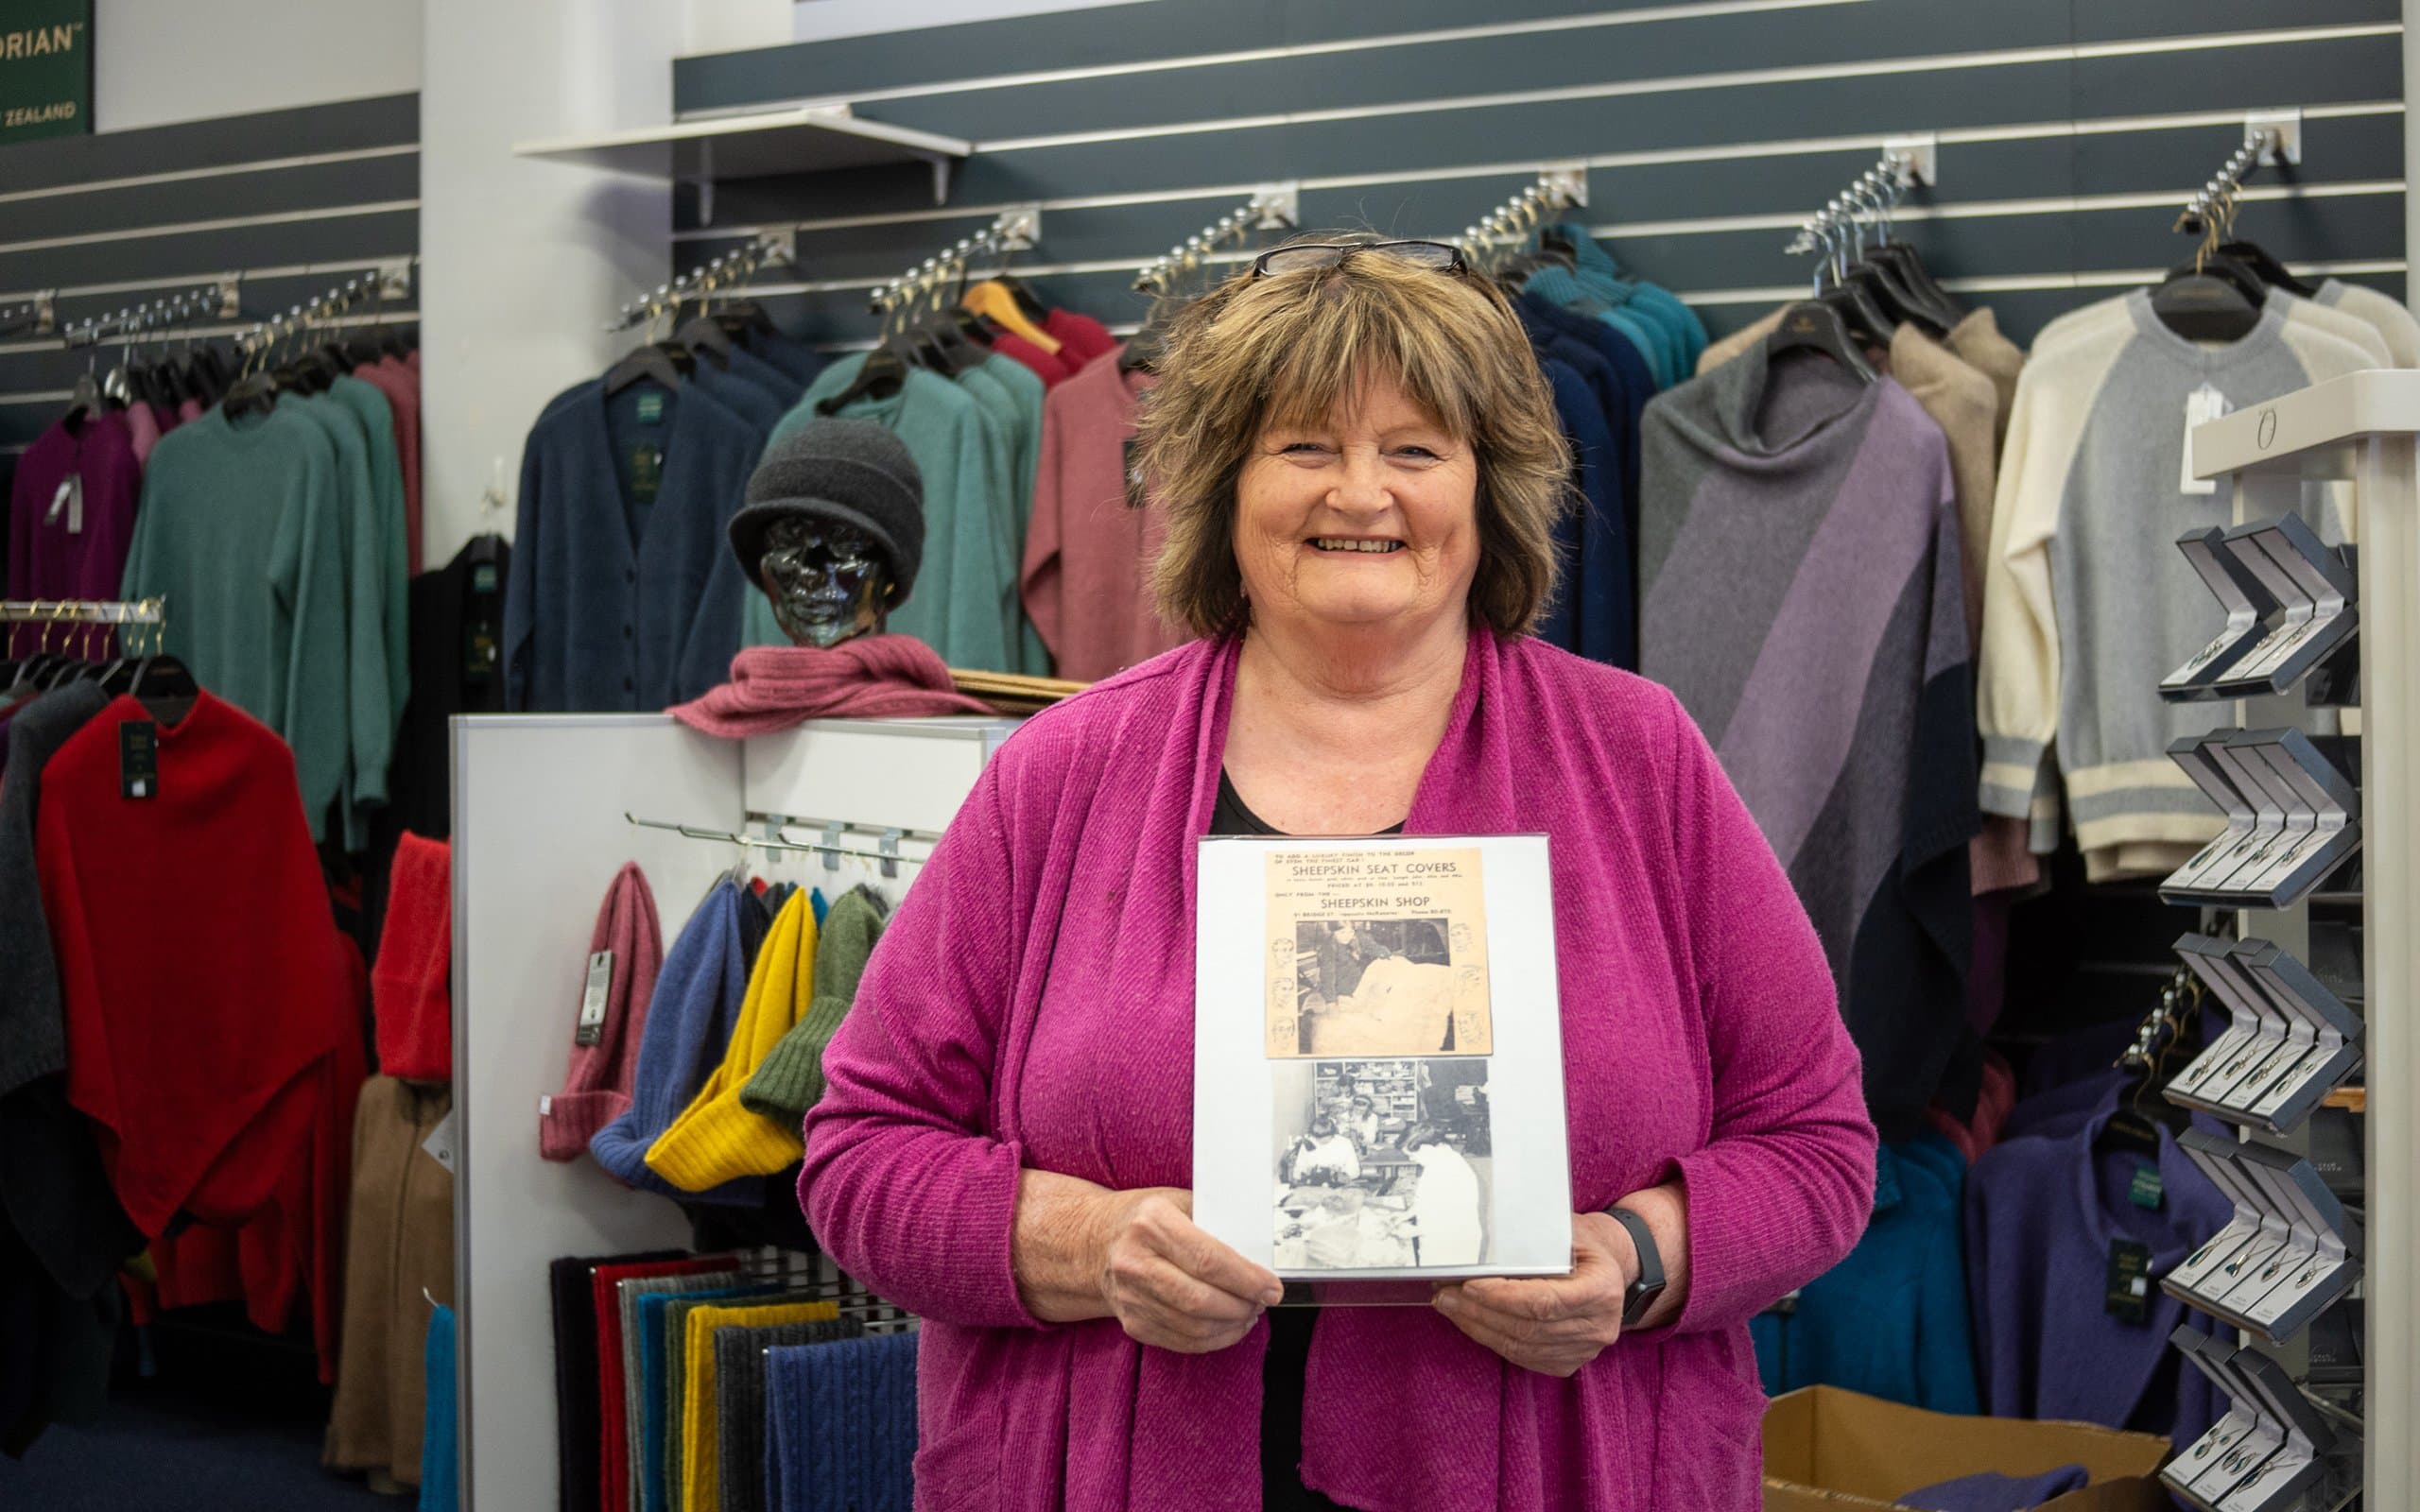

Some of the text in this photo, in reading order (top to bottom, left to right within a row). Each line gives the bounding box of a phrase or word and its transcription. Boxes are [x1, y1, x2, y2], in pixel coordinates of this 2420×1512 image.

[5, 101, 77, 128] ZEALAND
[1292, 862, 1457, 876] SHEEPSKIN SEAT COVERS
[1321, 896, 1430, 909] SHEEPSKIN SHOP
